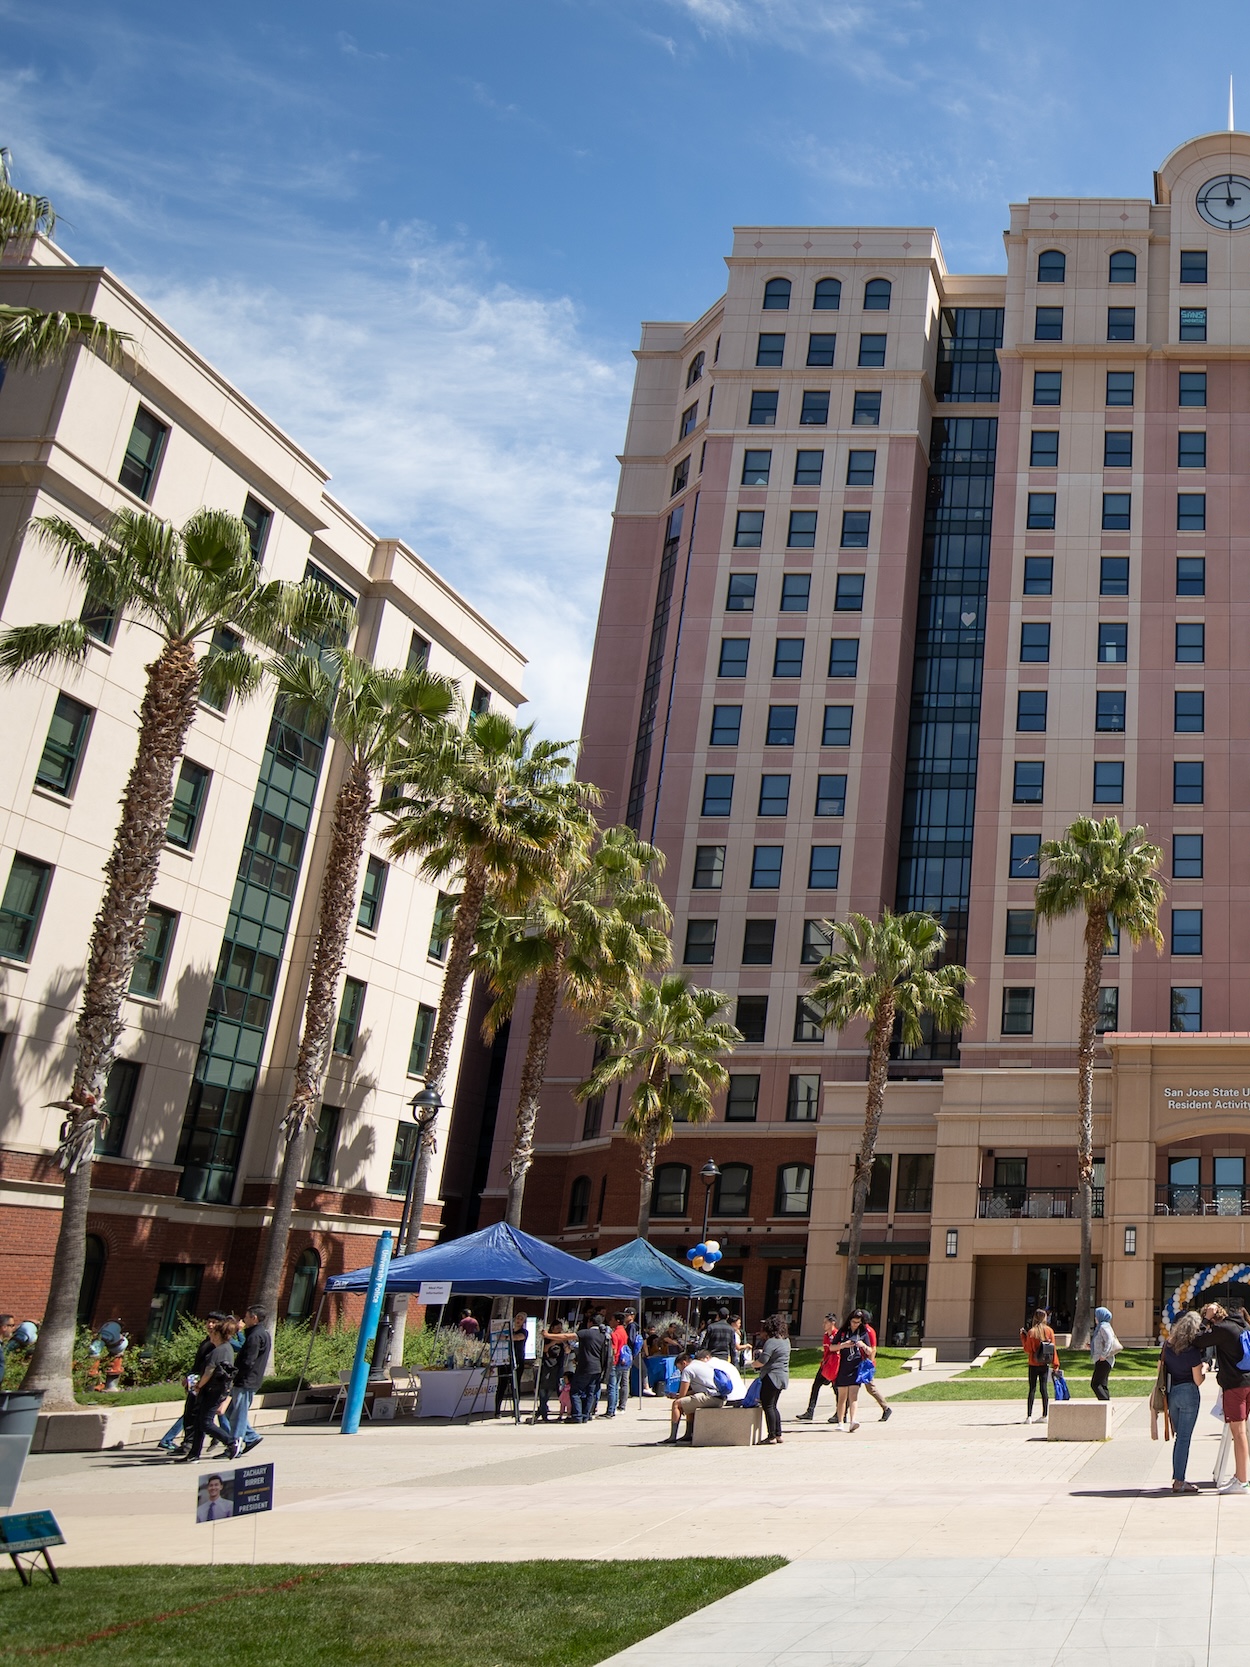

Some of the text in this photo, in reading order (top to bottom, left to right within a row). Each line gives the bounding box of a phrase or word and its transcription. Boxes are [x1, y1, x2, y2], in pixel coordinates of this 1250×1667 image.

[1164, 1087, 1183, 1097] San
[1186, 1087, 1210, 1097] Jose
[1212, 1087, 1239, 1097] State
[1168, 1100, 1212, 1109] Resident
[372, 1249, 389, 1304] University Police
[243, 1467, 267, 1478] ZACHARY
[247, 1494, 260, 1502] VICE
[238, 1501, 268, 1513] PRESIDENT
